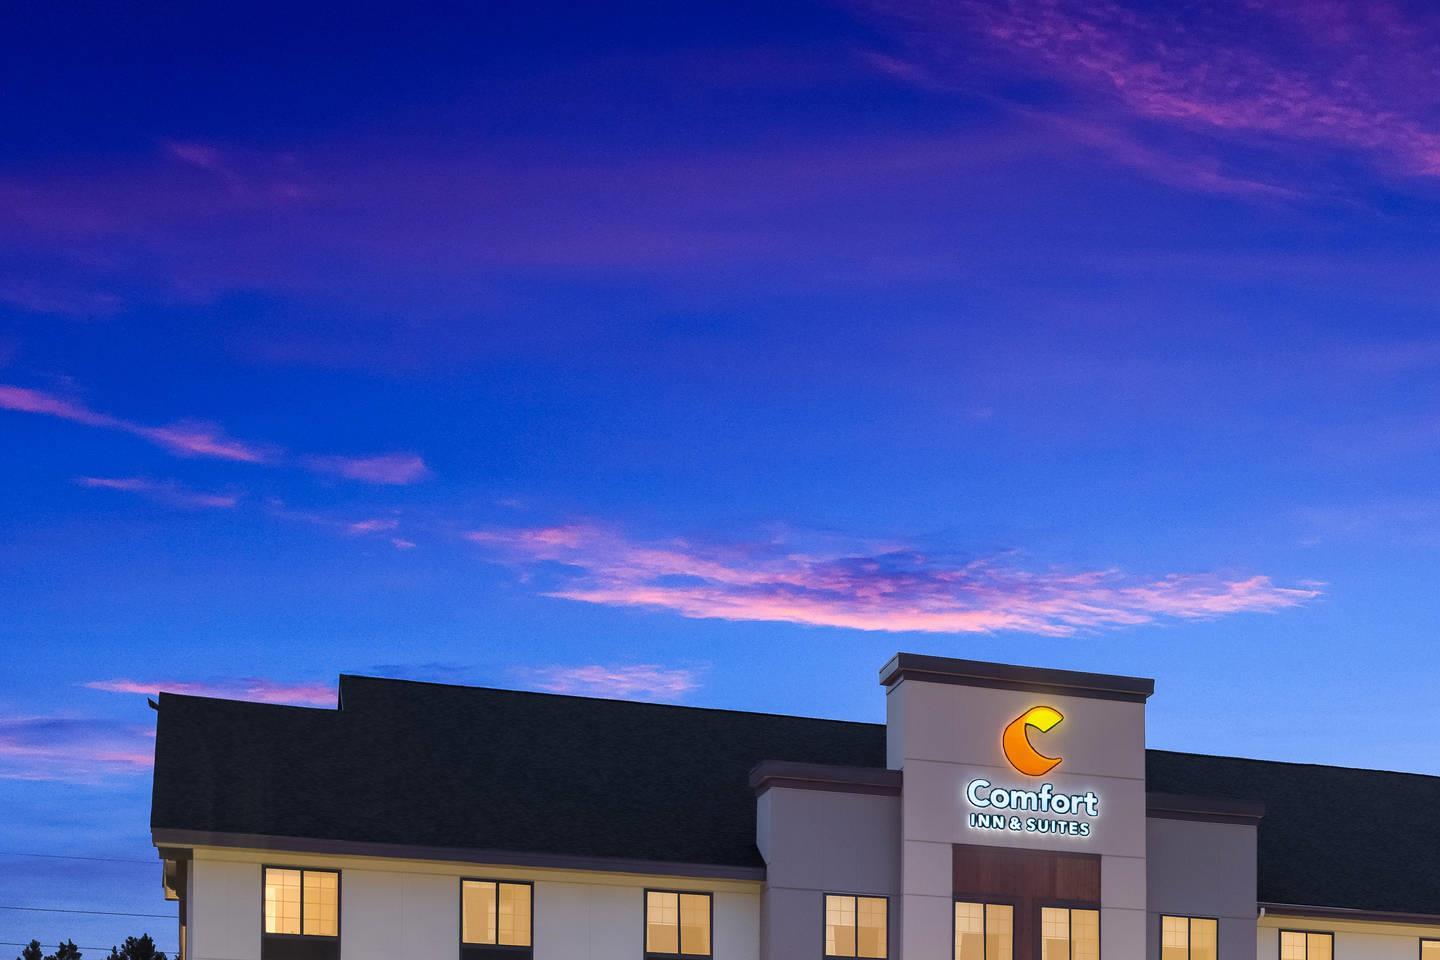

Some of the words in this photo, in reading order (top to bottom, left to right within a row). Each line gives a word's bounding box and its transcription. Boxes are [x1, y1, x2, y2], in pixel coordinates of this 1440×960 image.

[967, 778, 1098, 817] Comfort
[969, 812, 1006, 829] INN
[1008, 815, 1022, 832] &
[1025, 818, 1090, 837] SUITES
